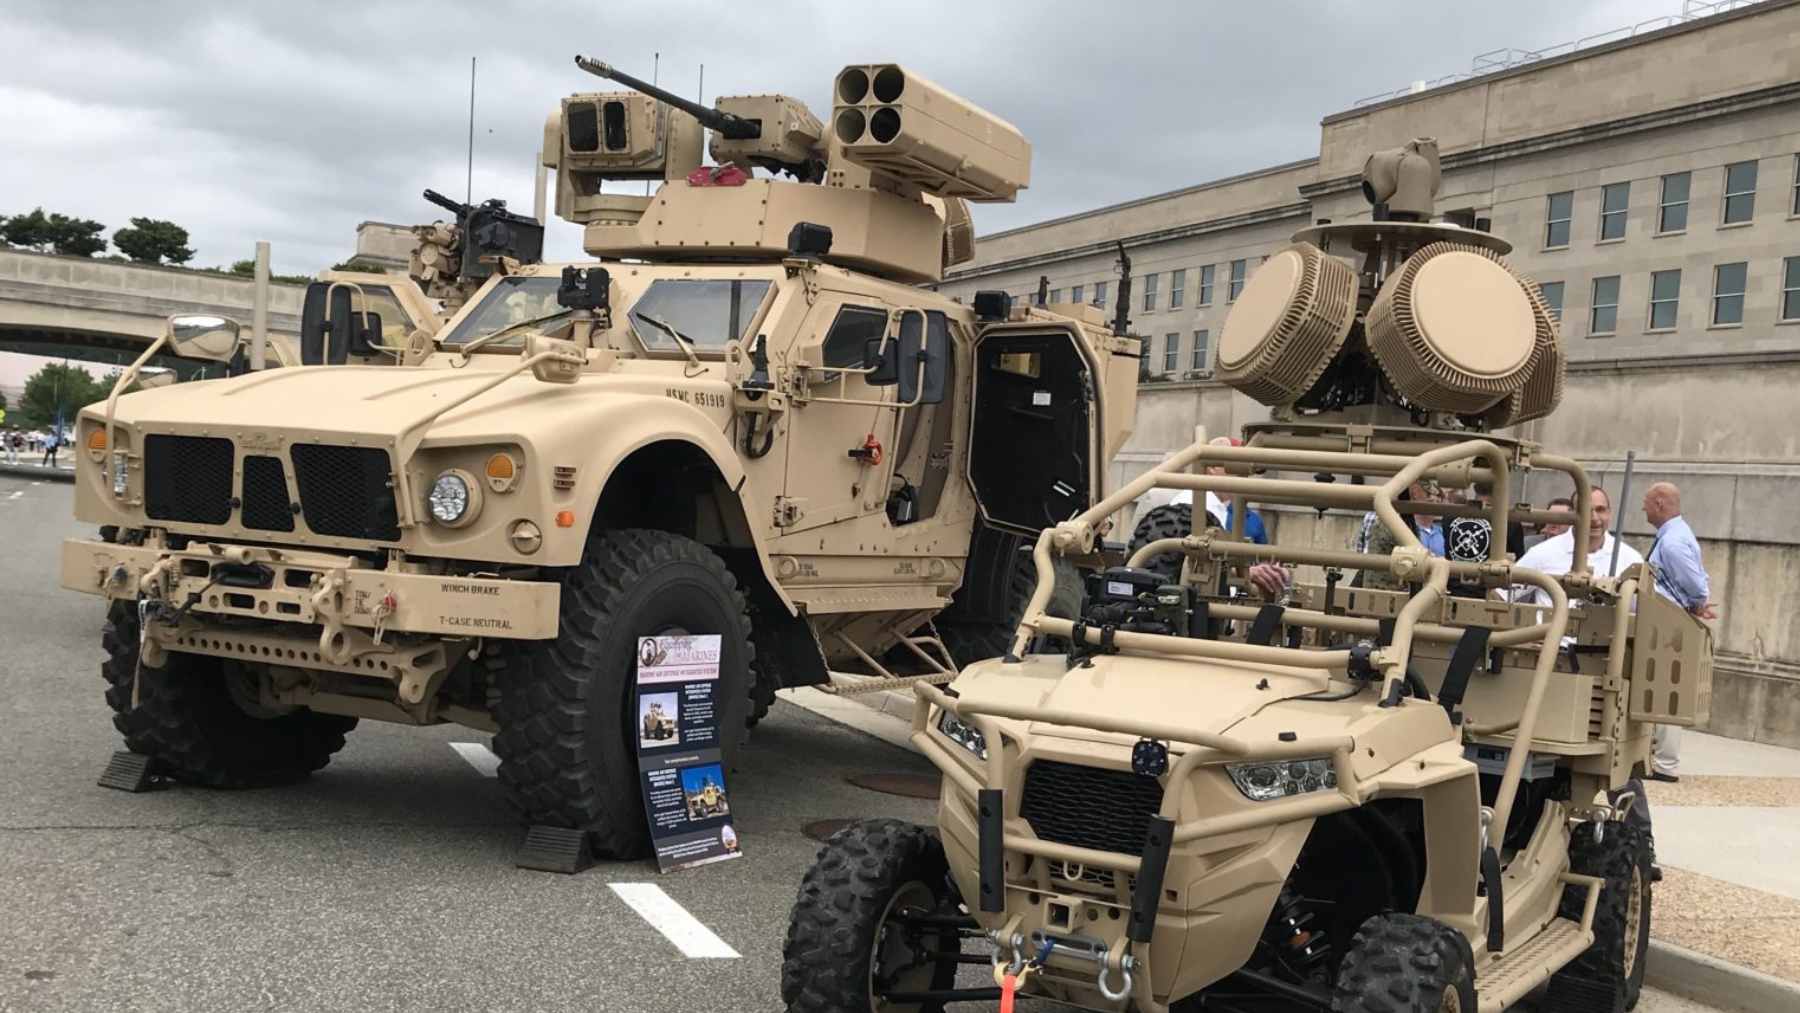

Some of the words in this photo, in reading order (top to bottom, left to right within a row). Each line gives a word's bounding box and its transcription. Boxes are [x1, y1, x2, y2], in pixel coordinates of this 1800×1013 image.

[665, 387, 689, 403] USMC
[694, 392, 725, 408] 651919
[441, 583, 469, 594] WINCH
[471, 586, 500, 596] BRAKE
[440, 616, 471, 627] T-CASE
[473, 619, 512, 630] NEUTRAL
